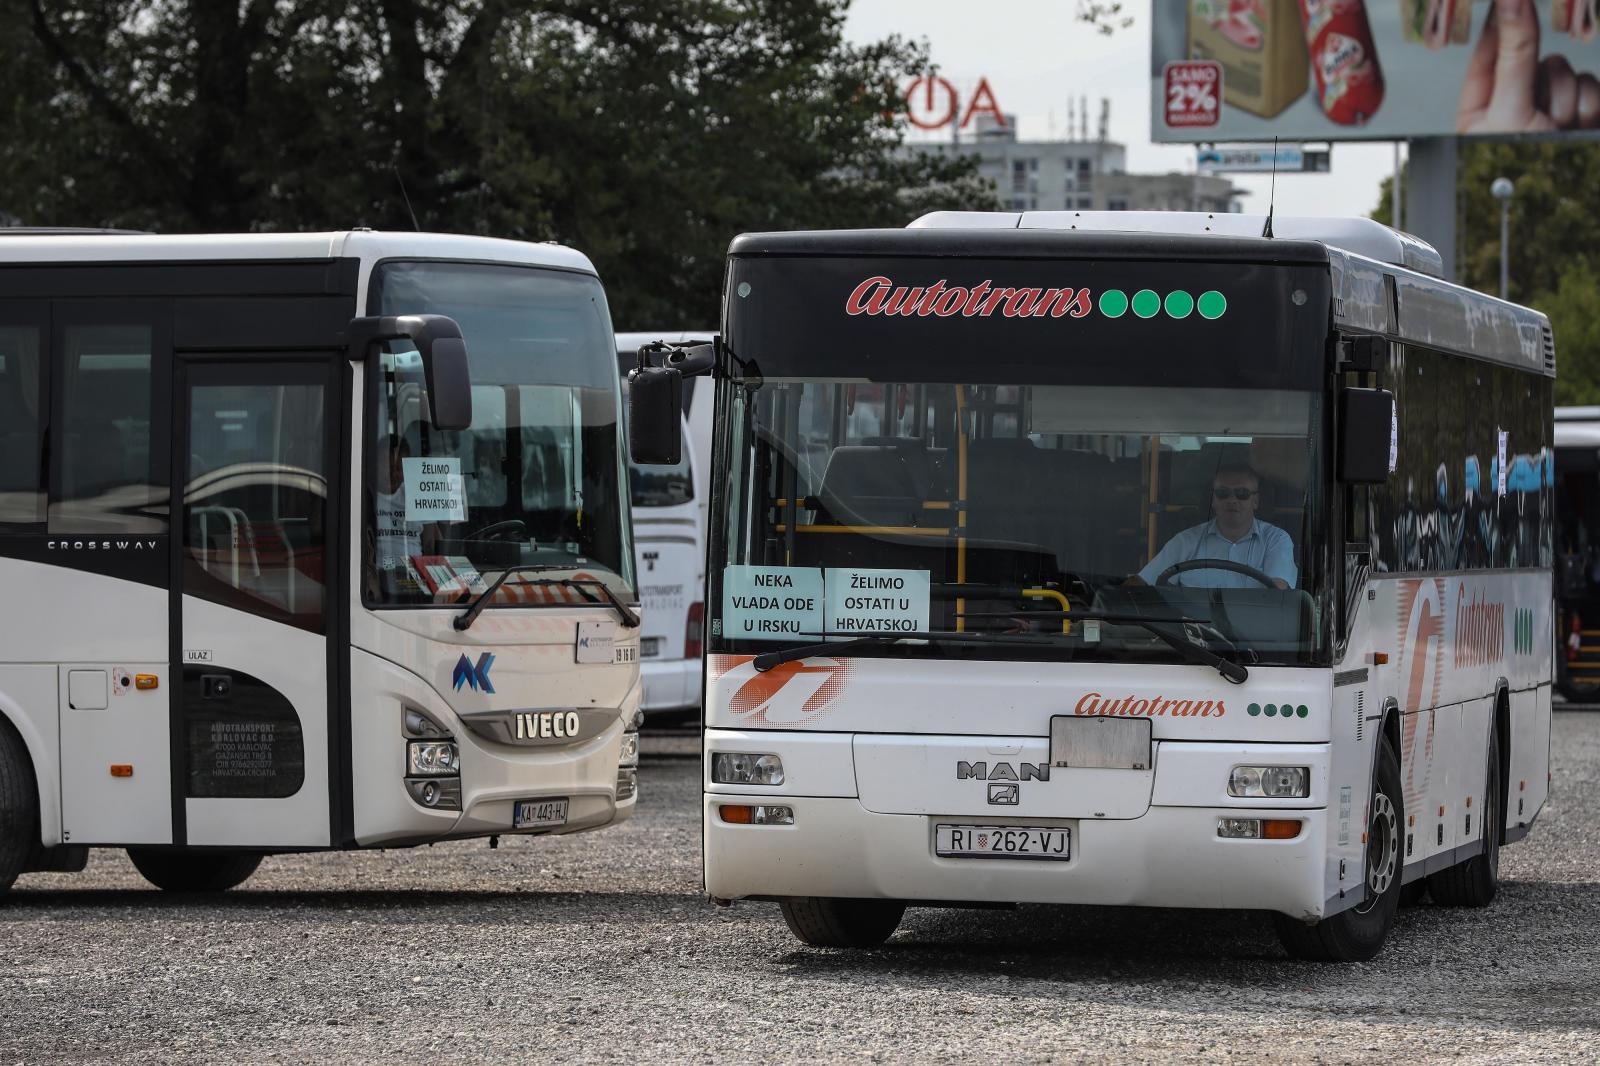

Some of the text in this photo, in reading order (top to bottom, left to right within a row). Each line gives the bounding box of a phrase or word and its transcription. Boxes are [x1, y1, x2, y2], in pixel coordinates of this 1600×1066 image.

[1170, 67, 1217, 82] SAMO
[1168, 83, 1217, 112] 2%
[421, 462, 450, 475] ŽELIMO
[419, 481, 453, 492] OSTATI U
[414, 499, 458, 509] HRVATSKOJ
[47, 541, 157, 550] CROSSWAY
[754, 574, 793, 588] NEKA
[850, 573, 905, 590] ŽELIMO
[731, 596, 814, 611] VLADA ODE
[844, 597, 909, 610] OSTATI U
[744, 619, 800, 633] U IRSKU
[836, 617, 918, 632] HRVATSKOJ
[188, 651, 208, 660] ULAZ
[211, 723, 275, 733] AUTOTRANSPORT
[515, 711, 580, 740] IVECO
[211, 733, 258, 743] KARLOVAC
[237, 743, 272, 752] KARLOVAC
[957, 760, 1050, 782] MAN
[521, 802, 567, 823] KA 443-HJ
[951, 830, 1065, 853] RI 262-VJ
